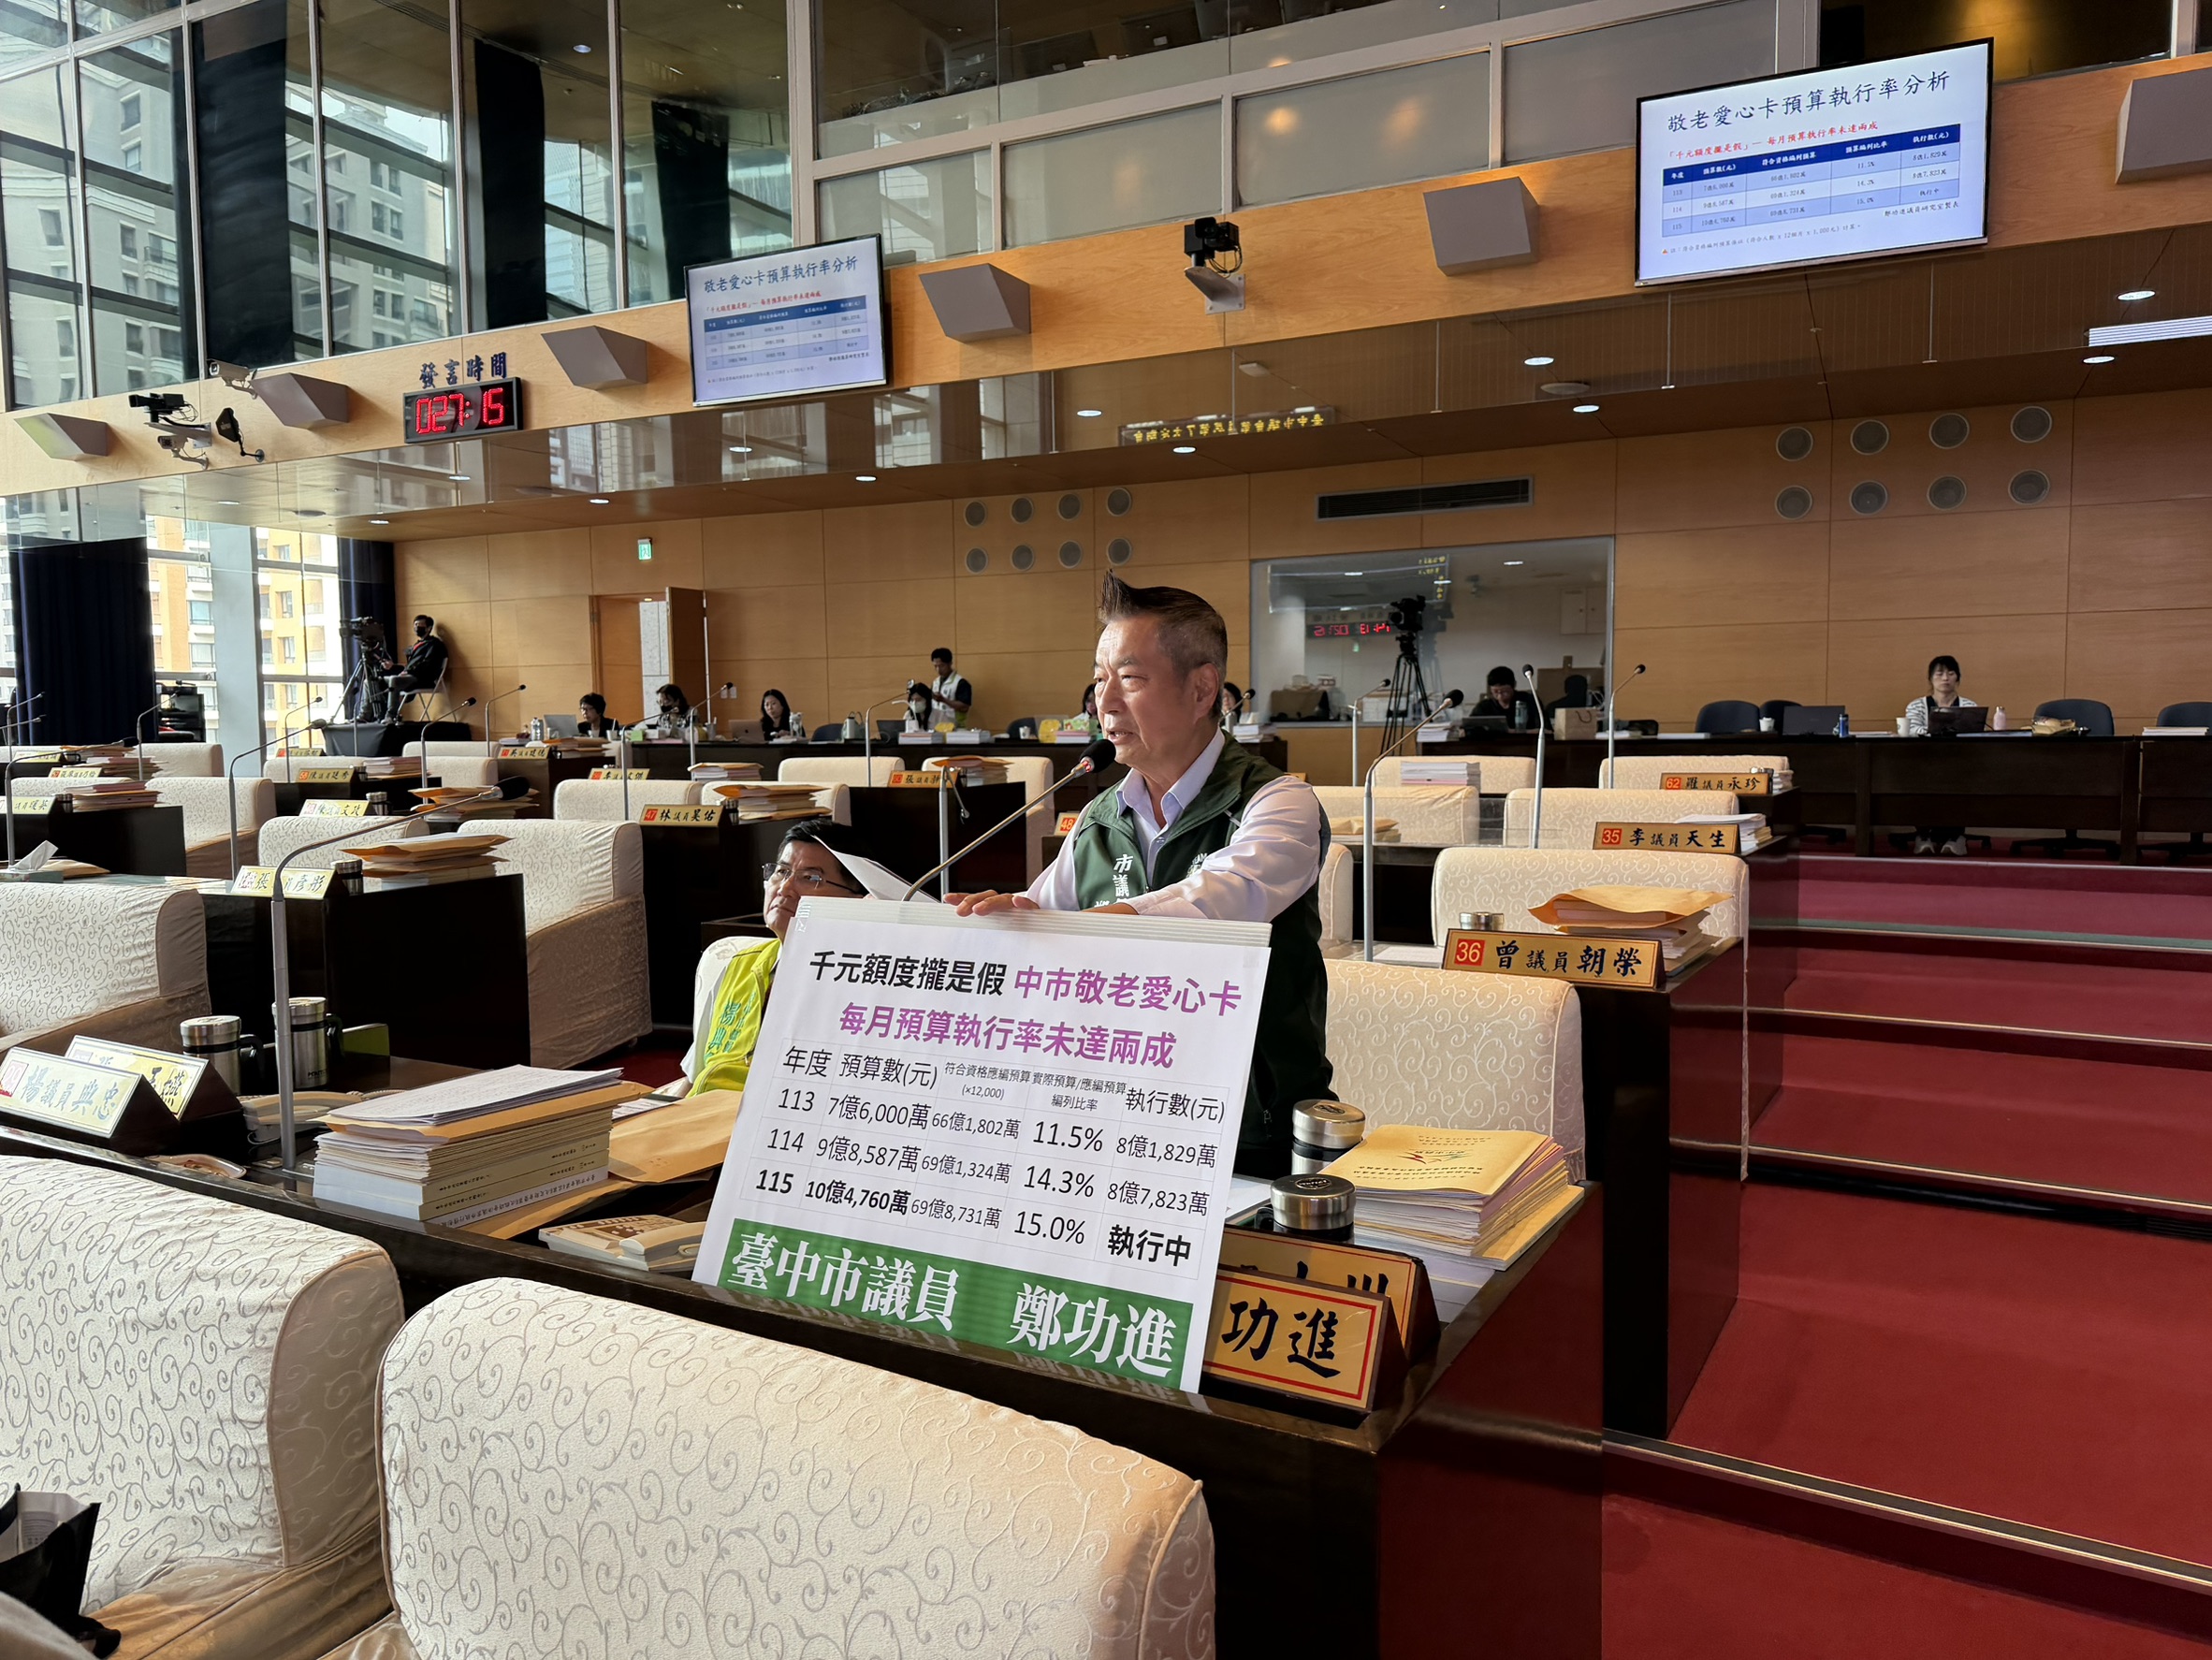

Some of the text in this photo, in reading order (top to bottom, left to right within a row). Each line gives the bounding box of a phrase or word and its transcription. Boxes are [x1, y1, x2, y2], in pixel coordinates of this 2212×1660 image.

[1668, 70, 1950, 133] 敬老愛心卡預算執行率分析
[1767, 122, 1879, 146] 每月預算執行率未達兩成
[704, 255, 859, 294] 敬老愛心卡預算執行率分析
[419, 351, 507, 389] 發言時間
[1666, 777, 1761, 791] 62 羅議員永珍
[644, 809, 657, 822] 47
[1061, 819, 1075, 832] 48
[1602, 827, 1726, 849] 35 李議員天生
[1112, 853, 1134, 903] 市議
[809, 950, 1243, 1017] 千元額度攏是假 中市敬老愛心卡
[1456, 939, 1642, 978] 36 曾議員朝榮
[839, 1001, 1177, 1070] 每月預算執行率未達兩成
[20, 1064, 120, 1121] 楊議員典忠
[782, 1045, 1226, 1125] 年度 預算數(元) 符合資格應編預算 實際預算/應編預算 執行數(元)
[1050, 1093, 1099, 1113] 編列比率
[778, 1087, 1218, 1169] 113 7億6,000萬 66億1,802萬 11.5% 8億1,829萬
[766, 1128, 1211, 1216] 114 9億8,587萬 69億1,324萬 14.3% 8億7,823萬
[755, 1169, 1192, 1267] 115 10億4,760萬 69億8,731萬 15.0% 執行中
[726, 1231, 1178, 1378] 臺中市議員 鄭功進
[1221, 1297, 1342, 1378] 功進
